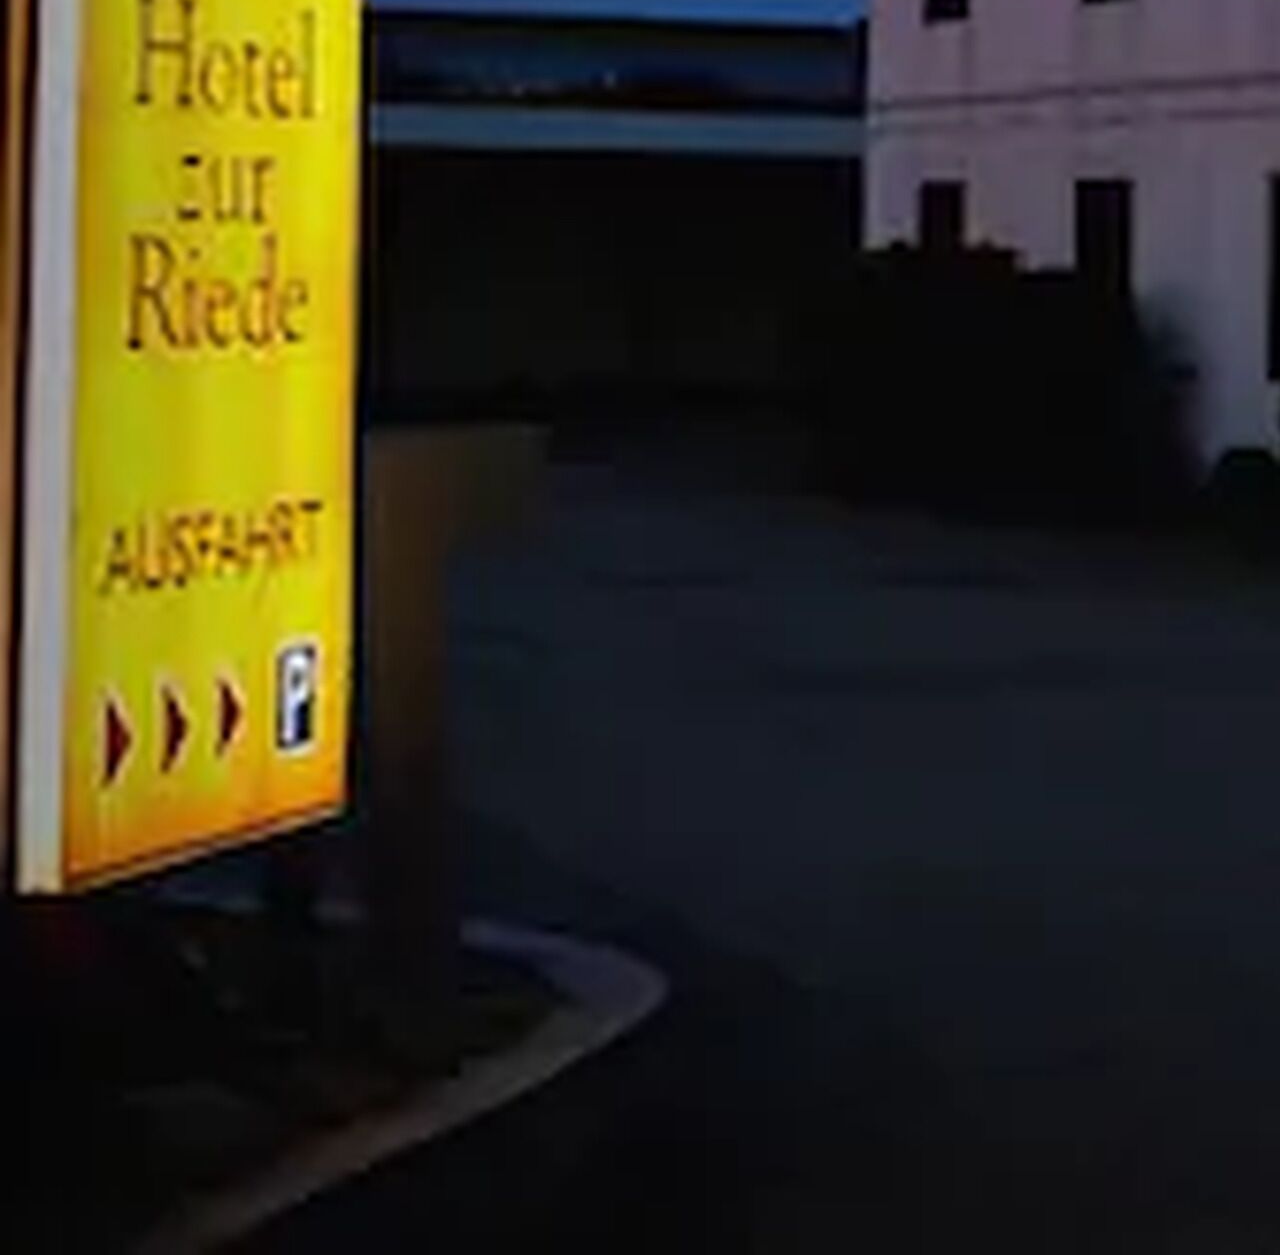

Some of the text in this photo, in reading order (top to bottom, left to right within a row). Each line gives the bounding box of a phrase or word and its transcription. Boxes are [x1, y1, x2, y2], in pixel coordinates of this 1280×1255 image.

[126, 233, 309, 352] Riede
[98, 499, 323, 595] AUSFAHRT
[281, 650, 313, 744] P
